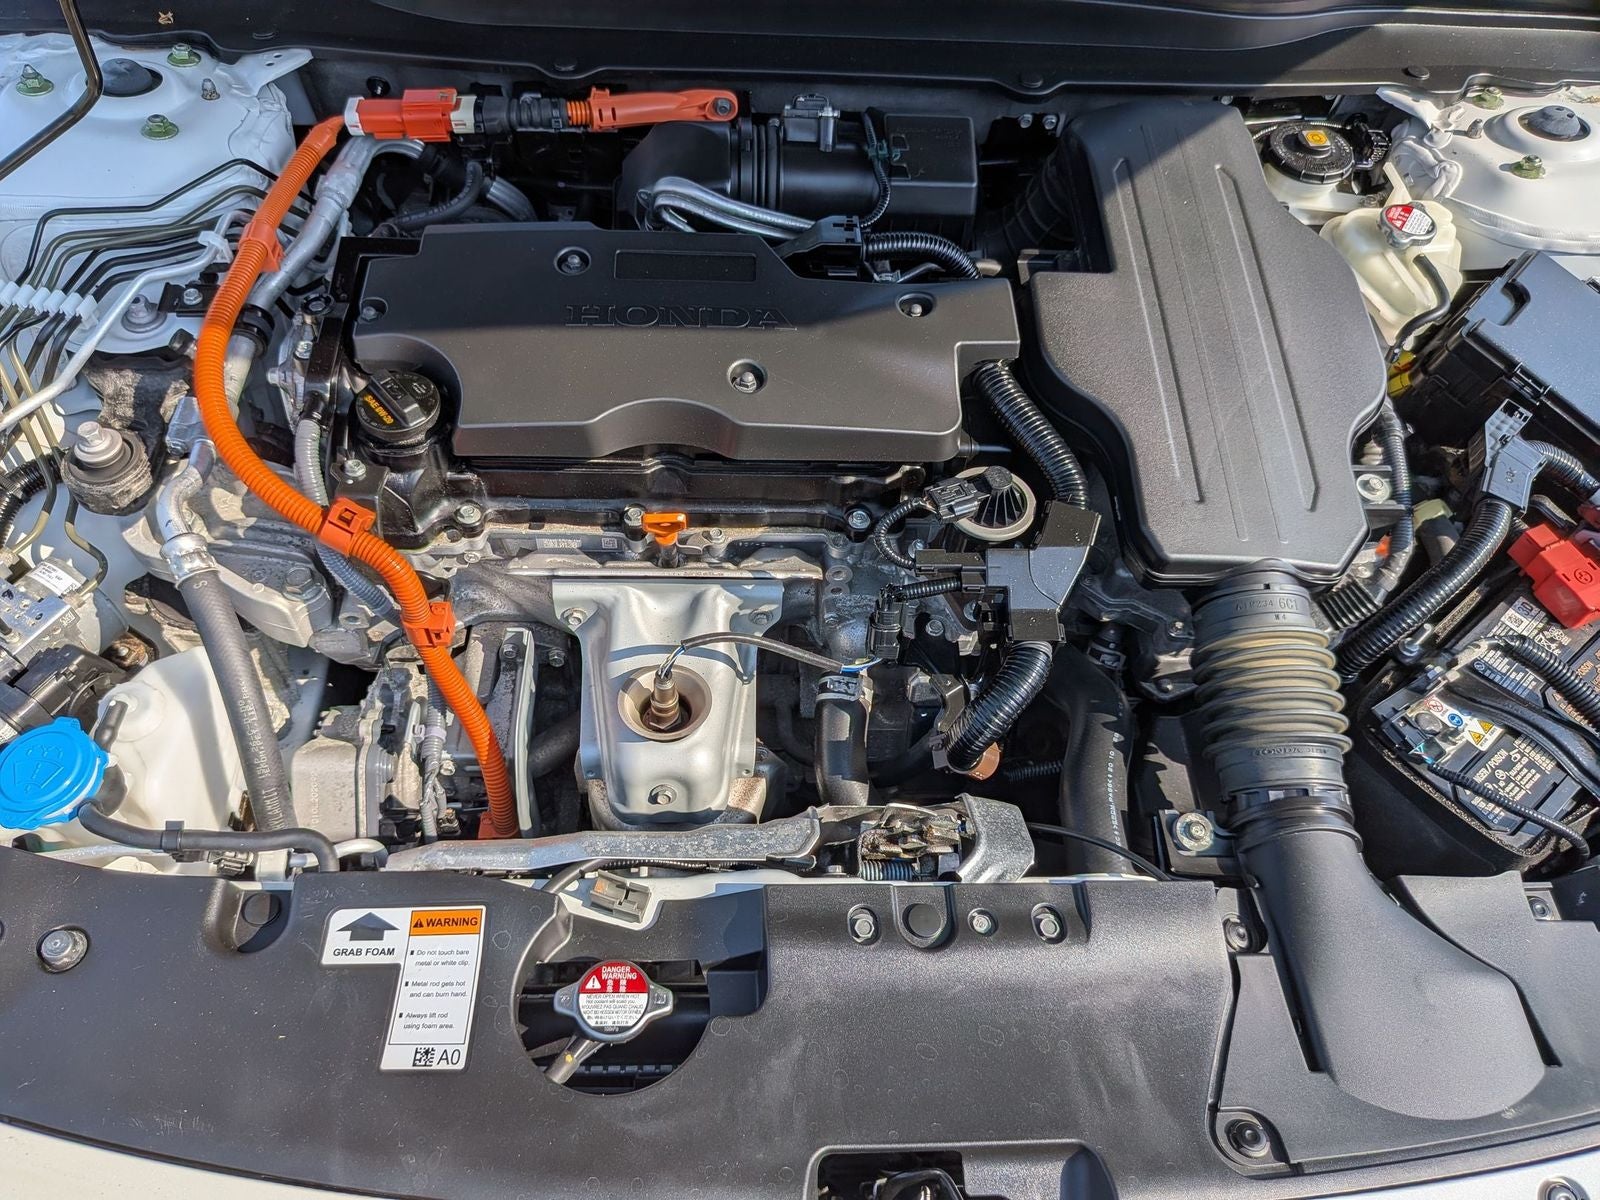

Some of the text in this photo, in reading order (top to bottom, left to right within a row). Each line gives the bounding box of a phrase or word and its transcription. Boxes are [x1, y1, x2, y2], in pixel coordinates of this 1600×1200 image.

[566, 304, 797, 331] HONDA
[426, 917, 478, 928] WARNING
[333, 948, 395, 956] GRAB FOAM
[602, 972, 637, 980] WARNUNG
[405, 1012, 427, 1020] Always
[437, 1049, 461, 1065] A0
